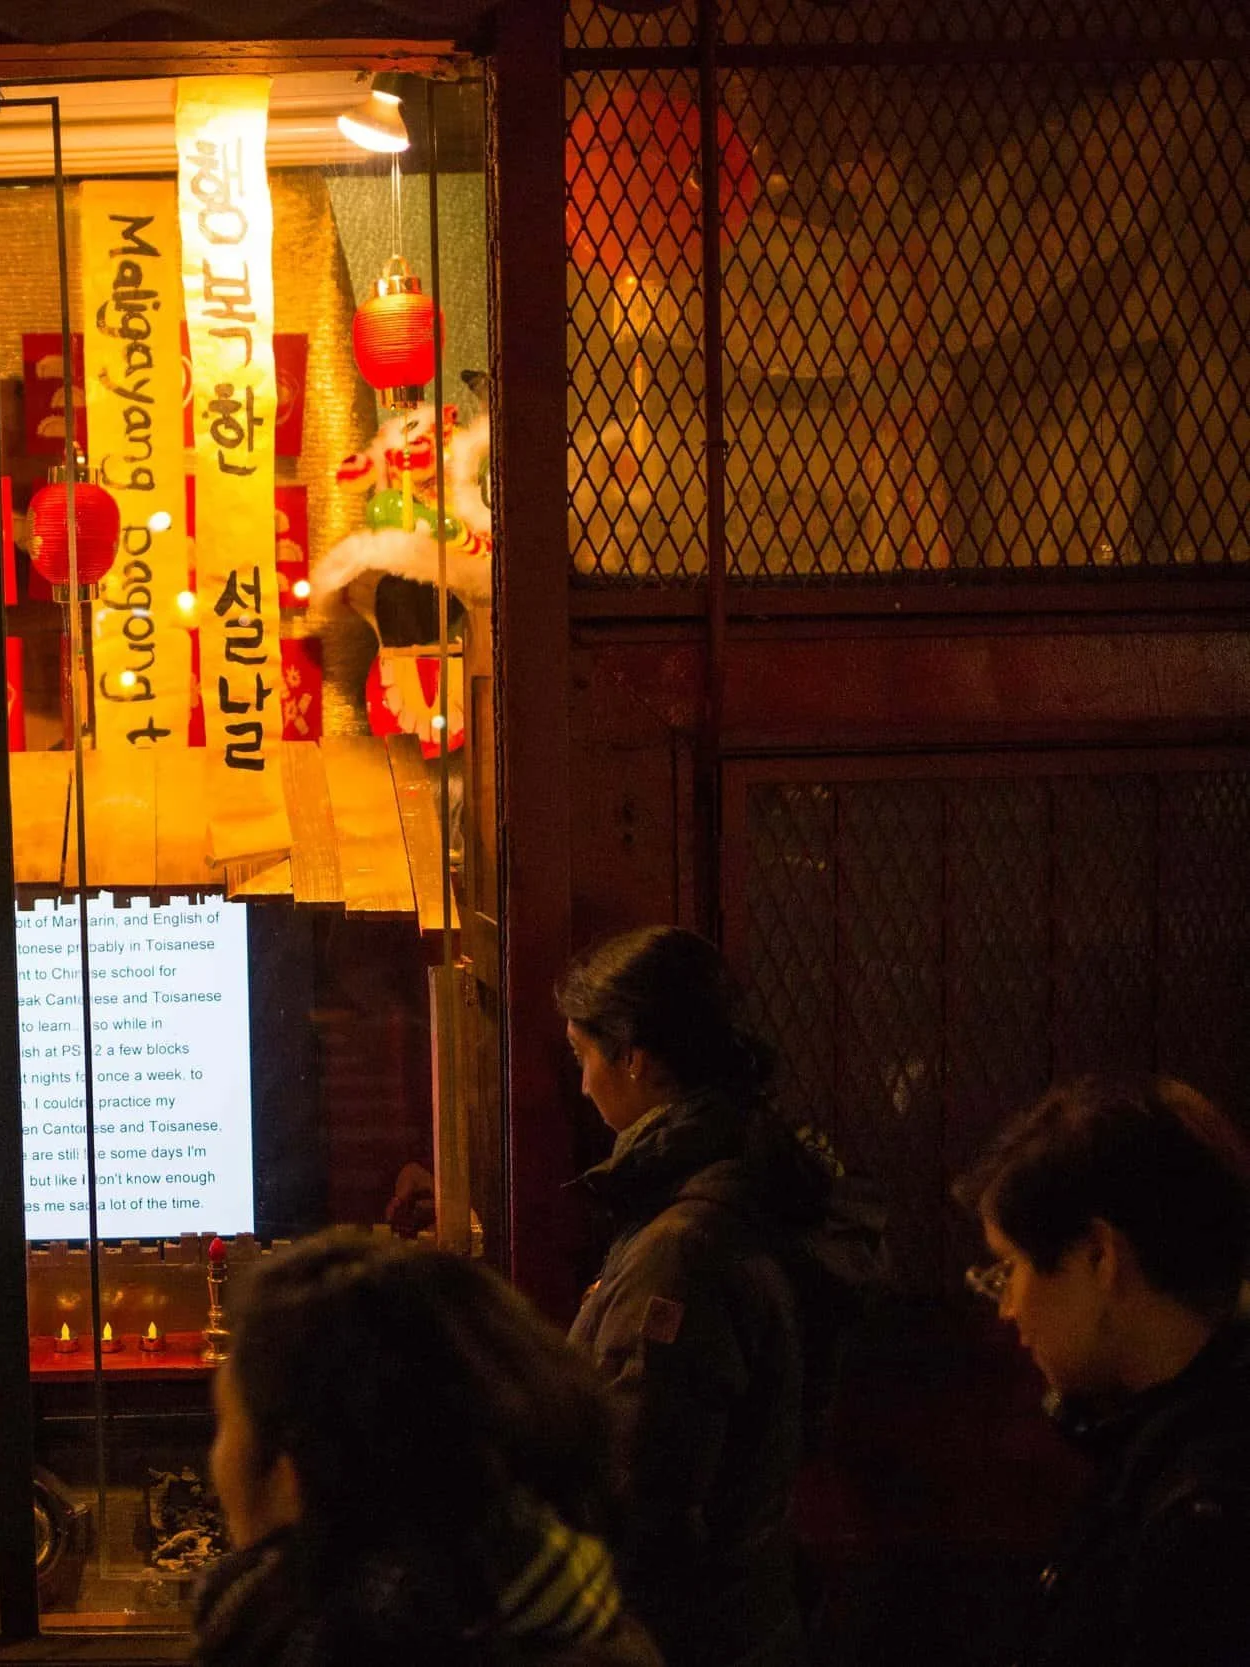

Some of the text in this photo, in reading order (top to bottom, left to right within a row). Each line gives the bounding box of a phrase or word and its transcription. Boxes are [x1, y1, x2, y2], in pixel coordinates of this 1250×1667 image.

[97, 213, 161, 493] Maligayang
[186, 137, 272, 772] 행복한 설날
[34, 916, 49, 929] of
[51, 914, 119, 930] Manarin,
[123, 913, 149, 927] and
[153, 912, 203, 929] English
[206, 911, 220, 925] of
[66, 939, 125, 957] prbably
[129, 939, 141, 952] in
[146, 937, 215, 952] Toisanese
[34, 967, 48, 980] to
[51, 965, 107, 980] Chinse
[110, 964, 155, 978] school
[159, 963, 177, 977] for
[122, 991, 149, 1004] and
[152, 989, 222, 1004] Toisanese
[21, 1019, 34, 1033] to
[92, 1020, 109, 1031] so
[112, 1016, 147, 1030] while
[151, 1016, 163, 1029] in
[44, 1045, 58, 1058] at
[61, 1044, 81, 1057] PS
[106, 1046, 115, 1056] a
[118, 1043, 143, 1056] few
[146, 1041, 190, 1055] blocks
[31, 1070, 72, 1087] nights
[96, 1071, 130, 1082] once
[134, 1071, 143, 1081] a
[190, 1066, 204, 1080] to
[98, 1094, 151, 1111] practice
[155, 1096, 176, 1110] my
[119, 1120, 144, 1134] and
[149, 1118, 223, 1133] Toisanese.
[32, 1150, 54, 1161] are
[57, 1147, 79, 1160] still
[110, 1148, 147, 1159] some
[150, 1145, 183, 1161] days
[187, 1144, 207, 1157] I'm
[29, 1174, 51, 1187] but
[54, 1173, 78, 1187] like
[95, 1172, 123, 1186] on't
[125, 1171, 162, 1185] know
[165, 1170, 216, 1187] enough
[44, 1202, 65, 1212] me
[97, 1201, 106, 1211] a
[109, 1198, 127, 1211] lot
[129, 1197, 144, 1210] of
[146, 1197, 168, 1210] the
[171, 1196, 204, 1210] time.
